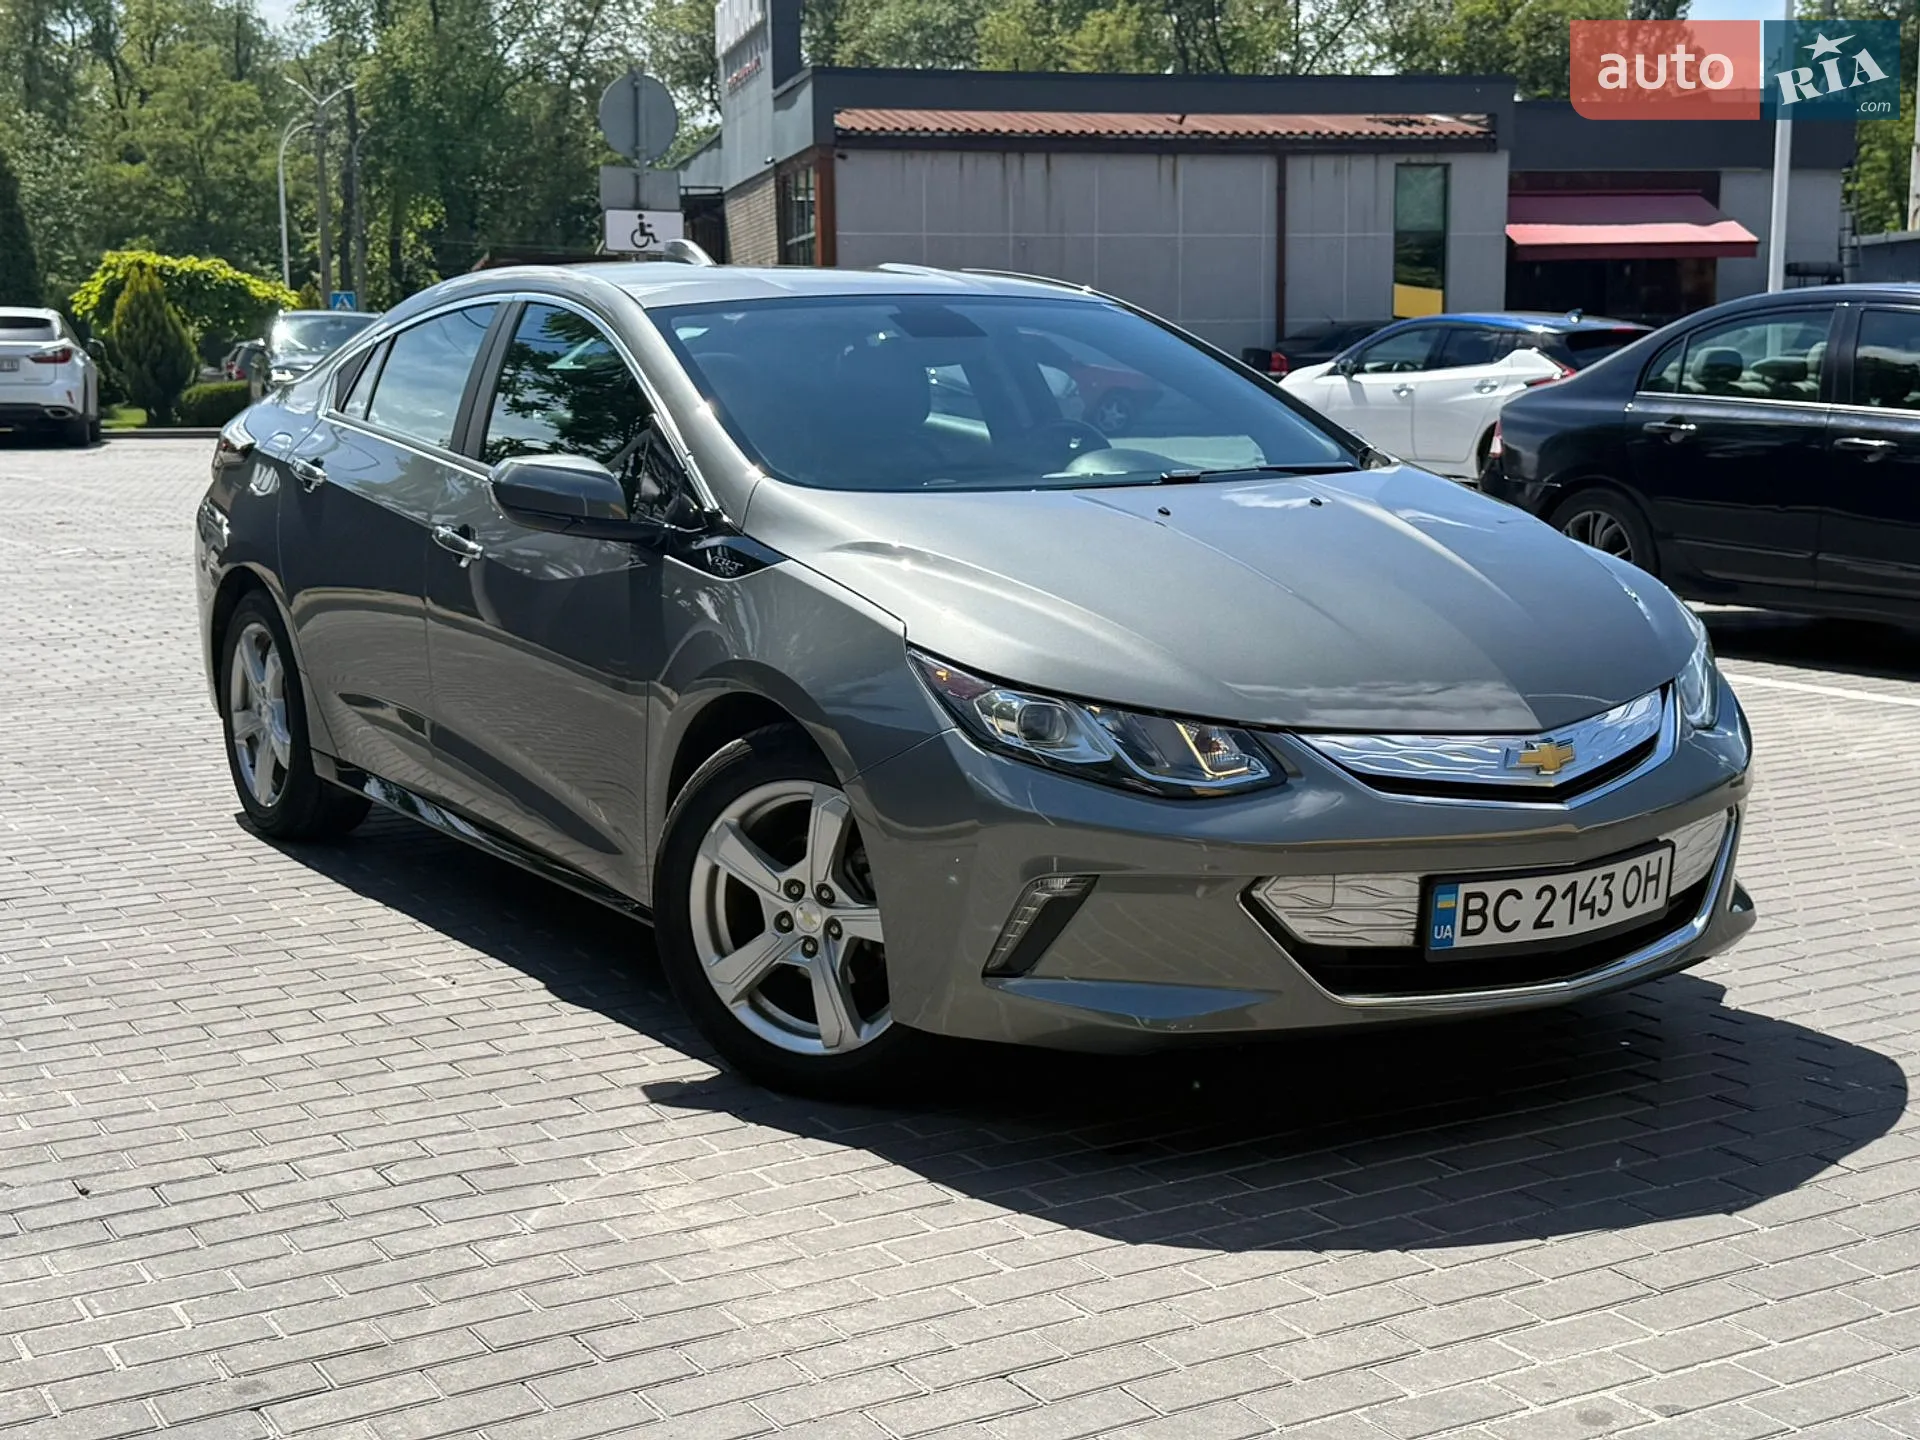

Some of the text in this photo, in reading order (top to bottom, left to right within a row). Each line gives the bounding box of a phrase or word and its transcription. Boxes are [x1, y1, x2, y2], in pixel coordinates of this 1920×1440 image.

[1460, 856, 1663, 937] BC 2143 OH
[1434, 924, 1453, 940] UA
